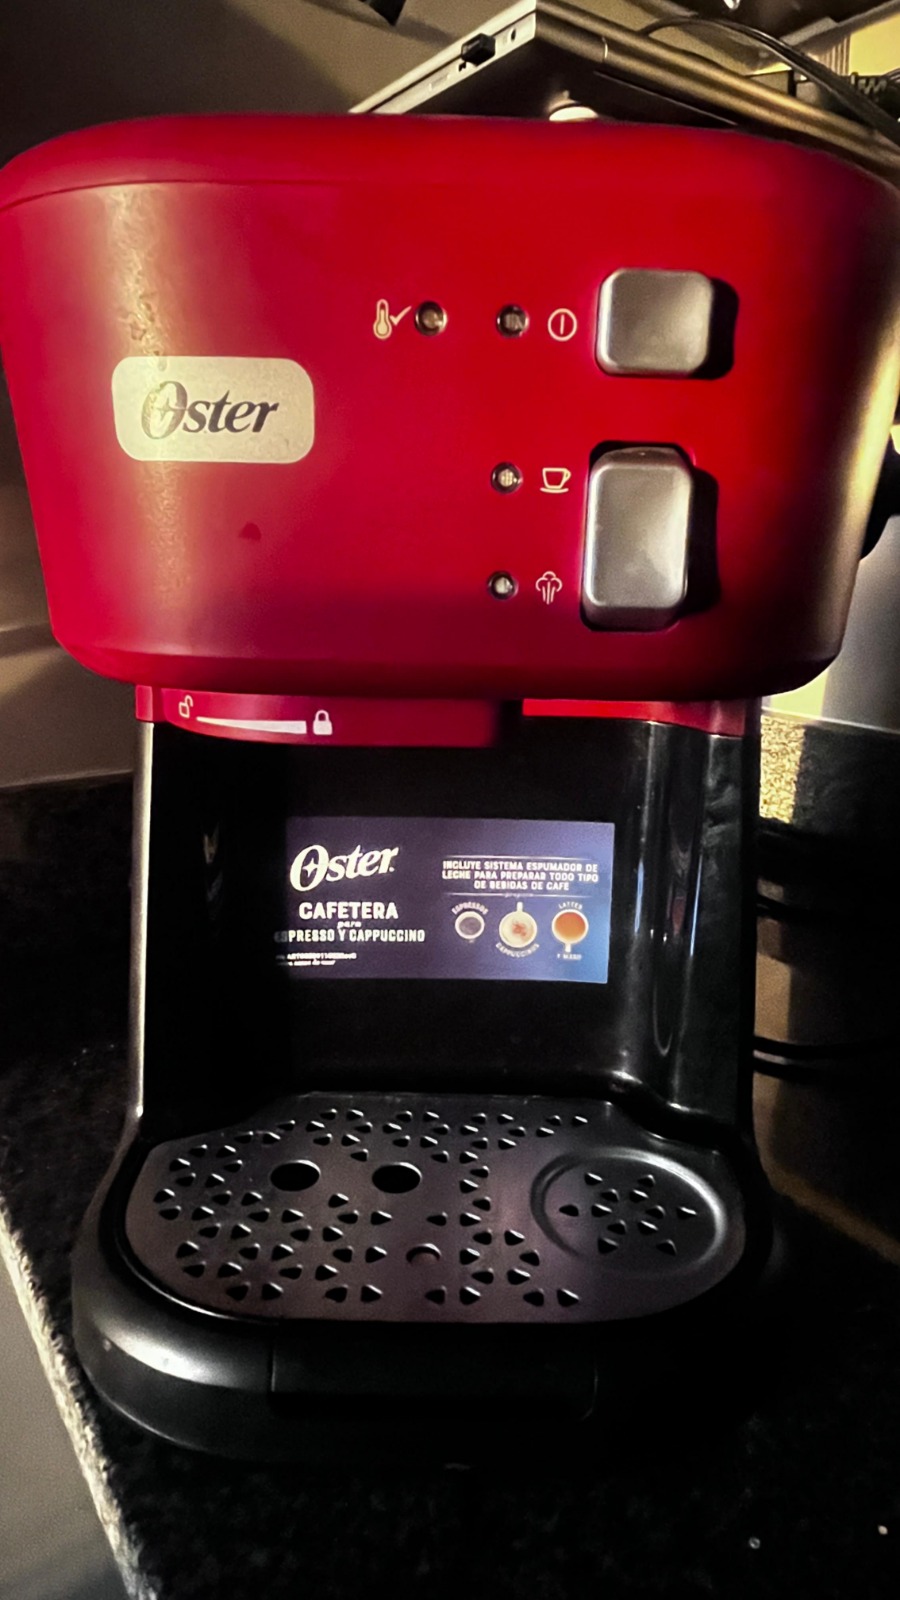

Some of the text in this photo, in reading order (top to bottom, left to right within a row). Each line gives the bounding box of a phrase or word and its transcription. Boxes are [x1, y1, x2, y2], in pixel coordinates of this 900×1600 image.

[141, 380, 279, 440] Oster
[442, 861, 598, 873] INCLUYE SISTEMA ESPUMADOR DE
[442, 870, 599, 883] LECHE PARA PREPARAR TODO TIPO
[474, 880, 486, 890] DE
[490, 881, 528, 890] BEBIDAS
[531, 881, 543, 890] DE
[299, 901, 399, 920] CAFETERA
[338, 929, 347, 942] Y
[349, 929, 426, 942] CAPPUCCINO
